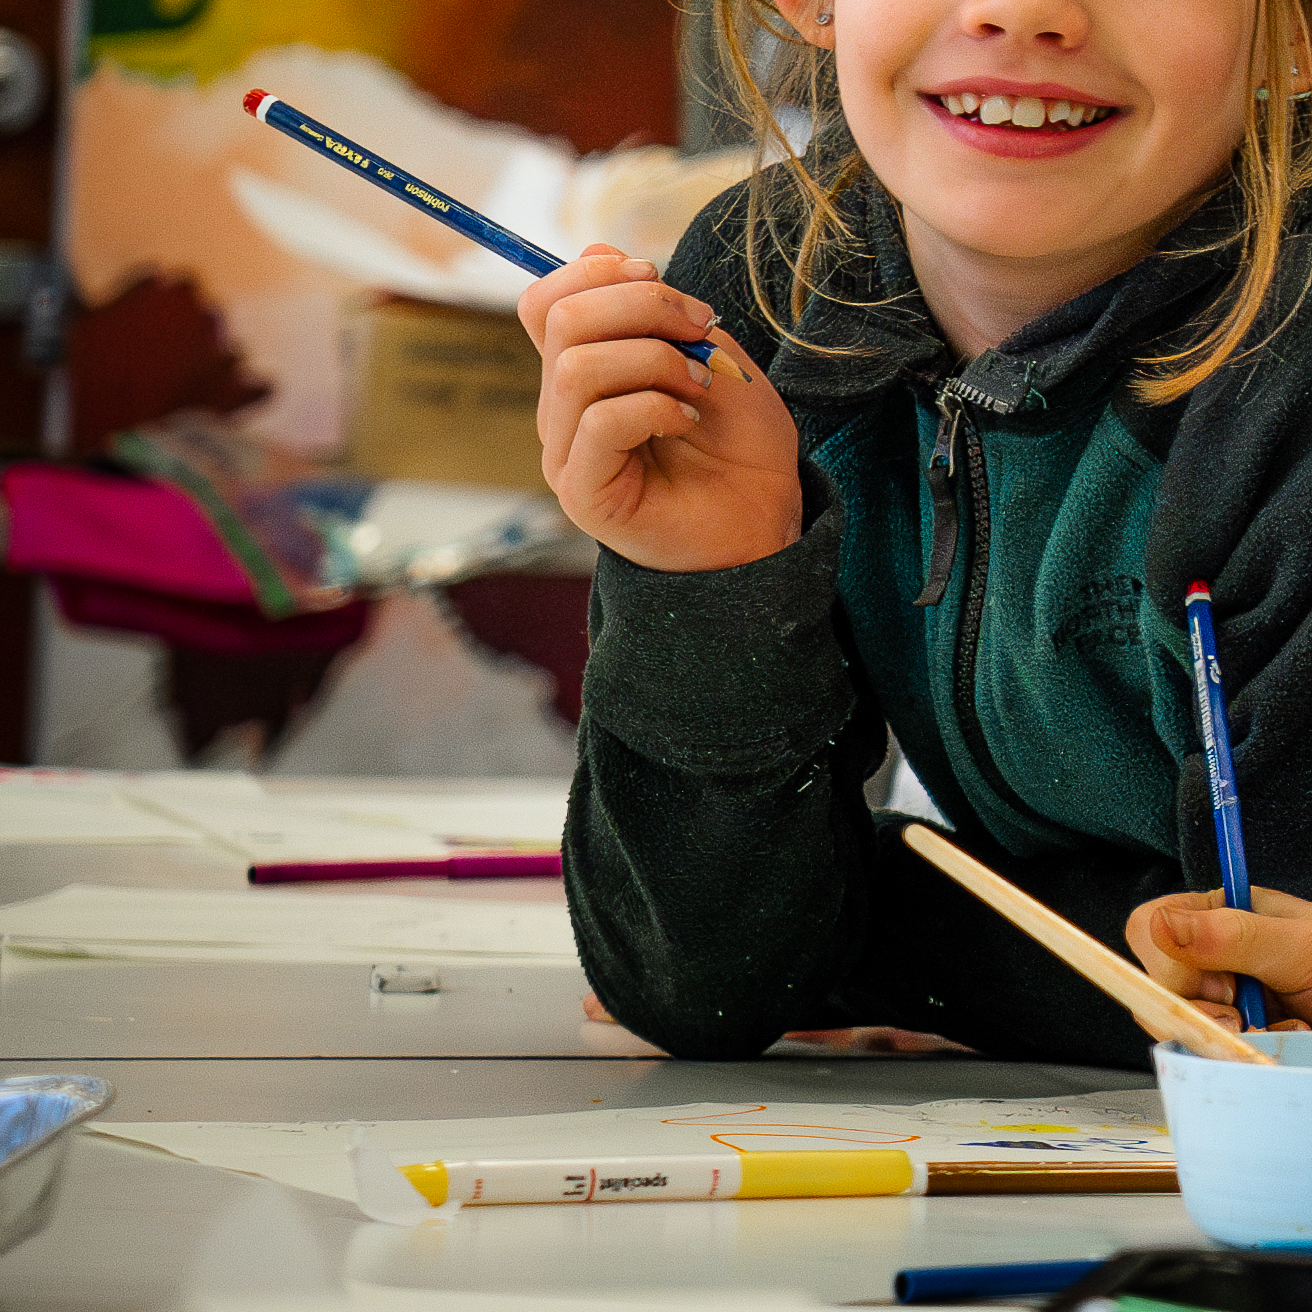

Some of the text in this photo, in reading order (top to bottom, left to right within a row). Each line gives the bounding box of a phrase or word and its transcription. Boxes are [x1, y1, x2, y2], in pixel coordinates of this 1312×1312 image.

[325, 135, 363, 165] LYRA
[404, 183, 450, 213] robinson
[599, 1172, 668, 1192] specialist
